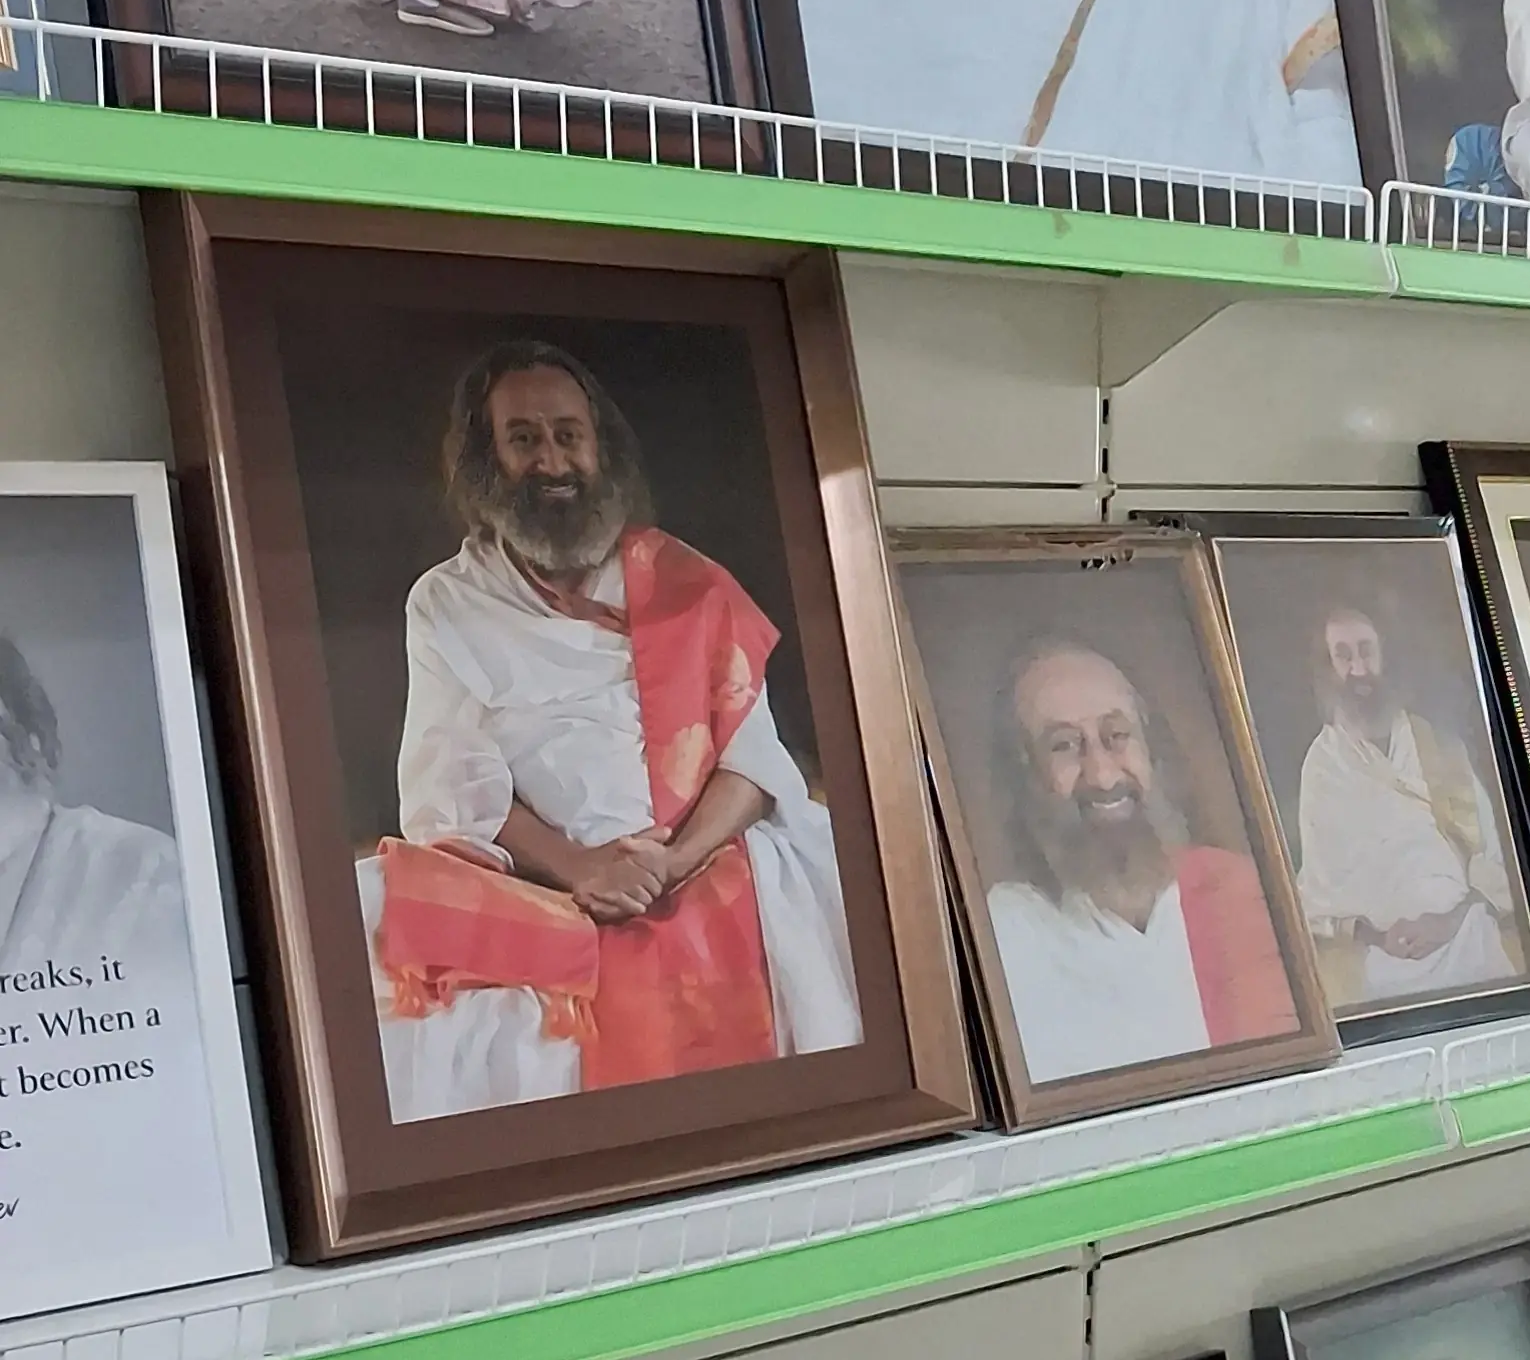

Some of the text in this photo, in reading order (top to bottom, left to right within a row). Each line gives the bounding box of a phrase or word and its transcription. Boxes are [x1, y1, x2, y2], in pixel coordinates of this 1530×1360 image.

[101, 955, 126, 982] it
[37, 1007, 136, 1039] When
[146, 1007, 162, 1028] a
[17, 1057, 155, 1095] becomes
